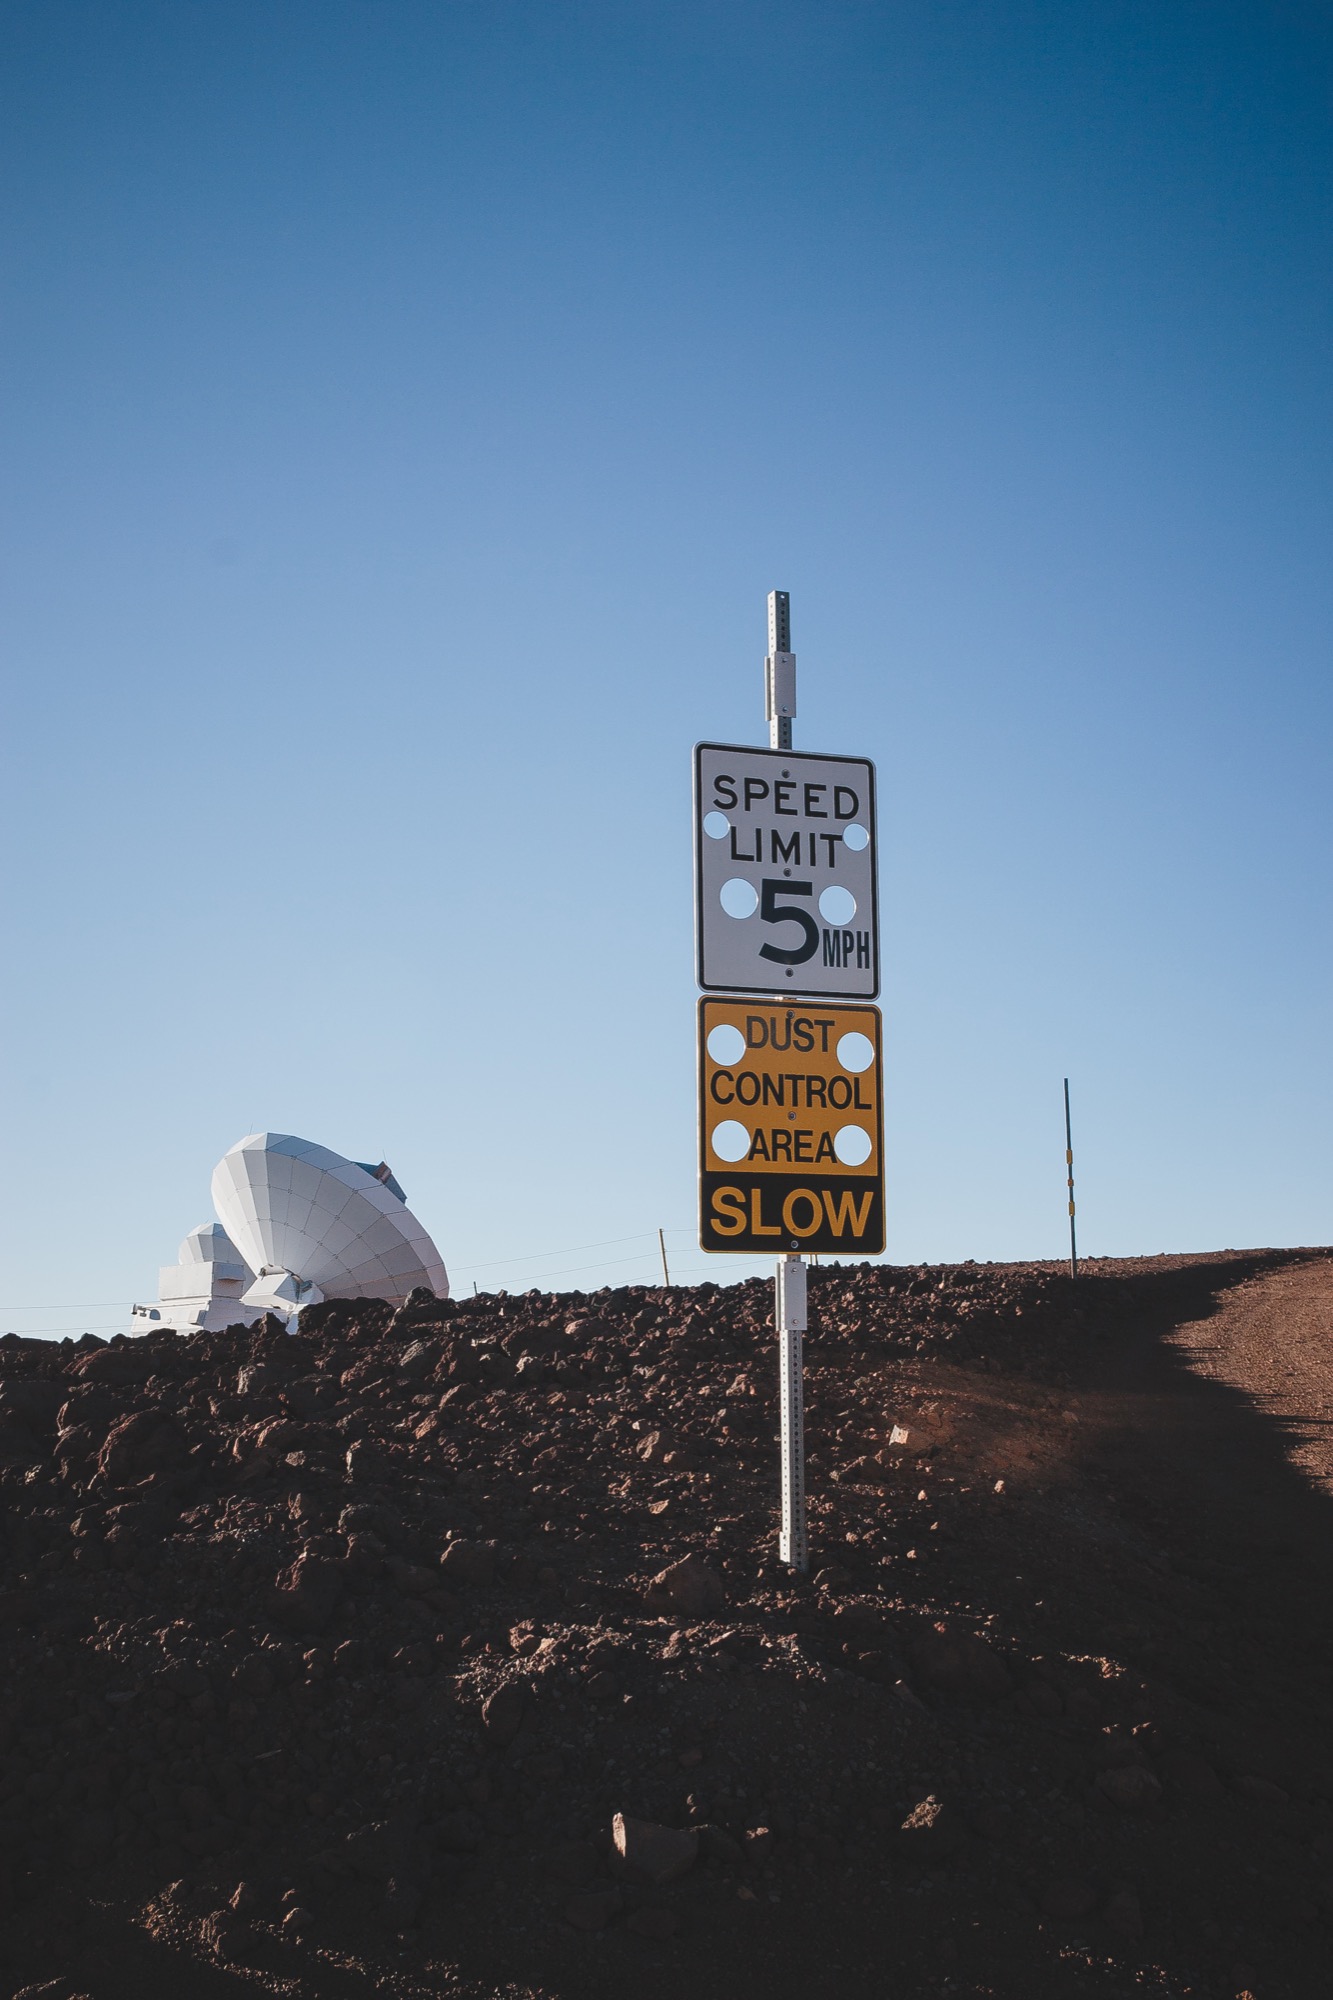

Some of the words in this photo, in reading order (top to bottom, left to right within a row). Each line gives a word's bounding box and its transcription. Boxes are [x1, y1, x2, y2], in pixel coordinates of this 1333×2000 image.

[713, 774, 859, 820] SPEED
[730, 826, 843, 868] LIMIT
[758, 878, 819, 966] 5
[822, 928, 870, 969] MPH
[746, 1015, 835, 1052] DUST
[710, 1070, 872, 1110] CONTROL
[747, 1128, 838, 1164] AREA
[710, 1186, 874, 1238] SLOW
